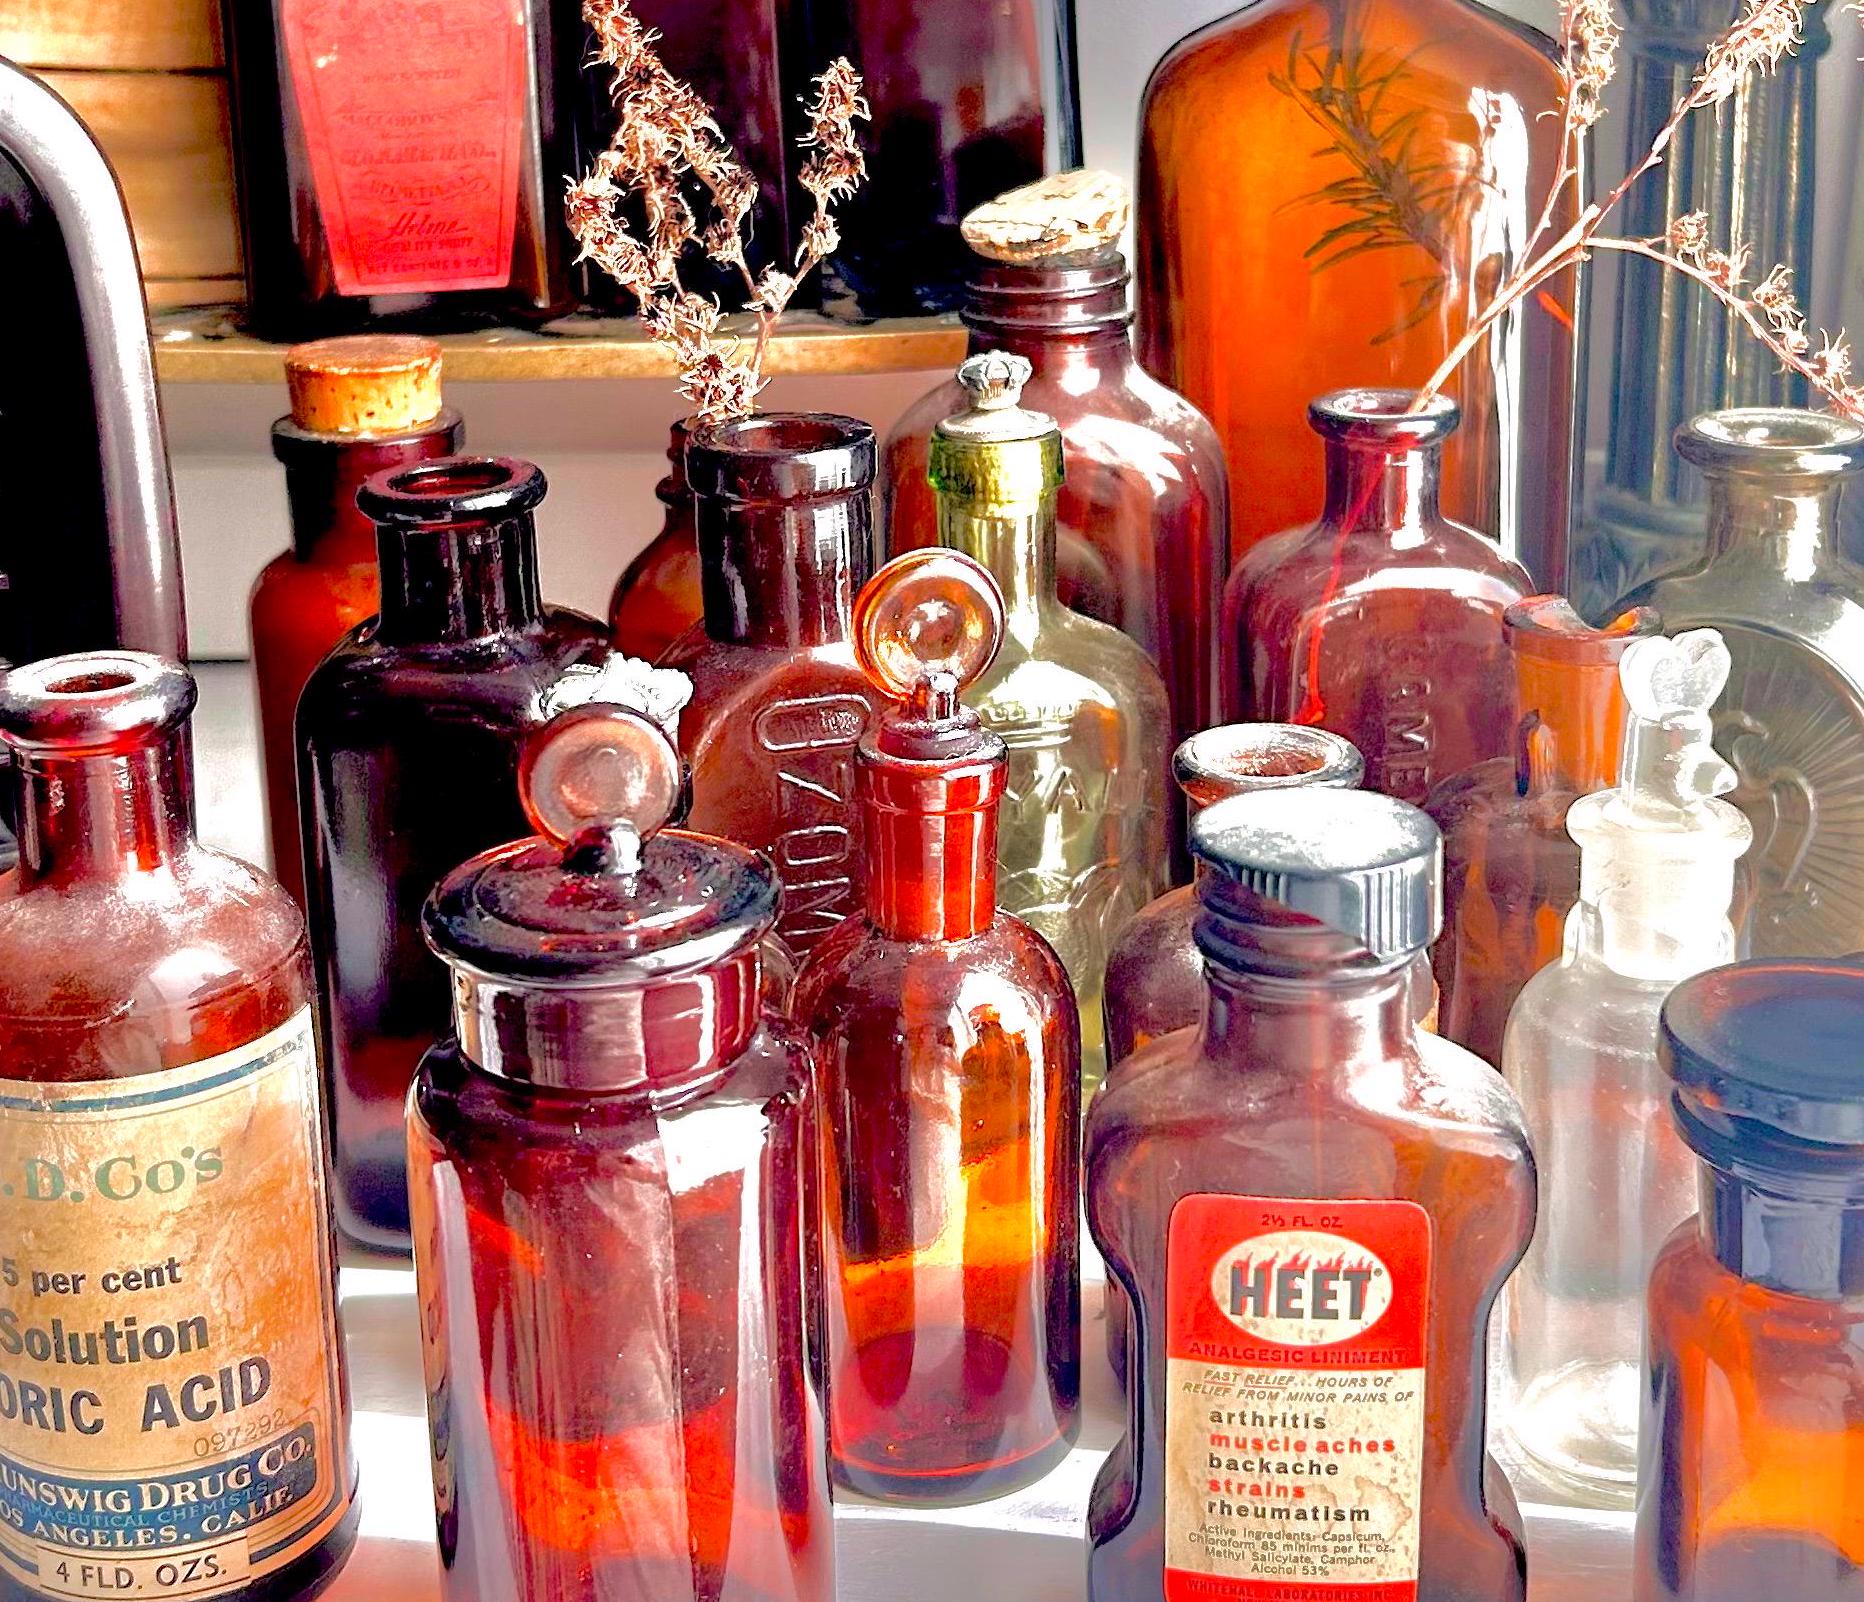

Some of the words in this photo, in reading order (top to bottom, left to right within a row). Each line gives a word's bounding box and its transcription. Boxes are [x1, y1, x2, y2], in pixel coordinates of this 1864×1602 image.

[2, 1258, 19, 1287] 5
[32, 1268, 86, 1297] per
[101, 1257, 183, 1294] cent
[1230, 1251, 1373, 1320] HEET
[0, 1308, 209, 1365] Solution
[1189, 1342, 1304, 1364] ANALGESIC
[1311, 1349, 1406, 1364] LINIMENT
[1203, 1369, 1240, 1383] FAST
[1316, 1376, 1368, 1388] HOURS
[1373, 1376, 1393, 1387] OF
[0, 1373, 105, 1435] ORIC
[141, 1356, 272, 1432] ACID
[1182, 1381, 1232, 1397] RELIEF
[1236, 1389, 1280, 1401] FROM
[1286, 1391, 1337, 1403] MINOR
[1343, 1391, 1386, 1403] PAINS
[1394, 1391, 1414, 1402] OF
[1208, 1409, 1327, 1430] arthritis
[1209, 1432, 1308, 1453] muscle
[1315, 1436, 1396, 1453] aches
[1208, 1452, 1339, 1477] backache
[1, 1462, 133, 1514] UNSWIG
[1207, 1477, 1306, 1498] strains
[157, 1480, 269, 1524] CHEMISTS
[201, 1485, 295, 1534] CALIF.
[1207, 1500, 1370, 1521] rheumatism
[1199, 1523, 1237, 1537] Active
[1188, 1532, 1255, 1549] Chloroform
[1260, 1541, 1277, 1551] 85
[1282, 1542, 1328, 1553] minims
[1333, 1545, 1354, 1554] per
[1205, 1548, 1245, 1562] Methyl
[1320, 1554, 1376, 1566] Camphor
[56, 1561, 70, 1584] 4
[81, 1565, 143, 1590] FLD.
[155, 1554, 227, 1587] OZS.
[1251, 1563, 1297, 1576] Alcohol
[1301, 1565, 1330, 1577] 53%
